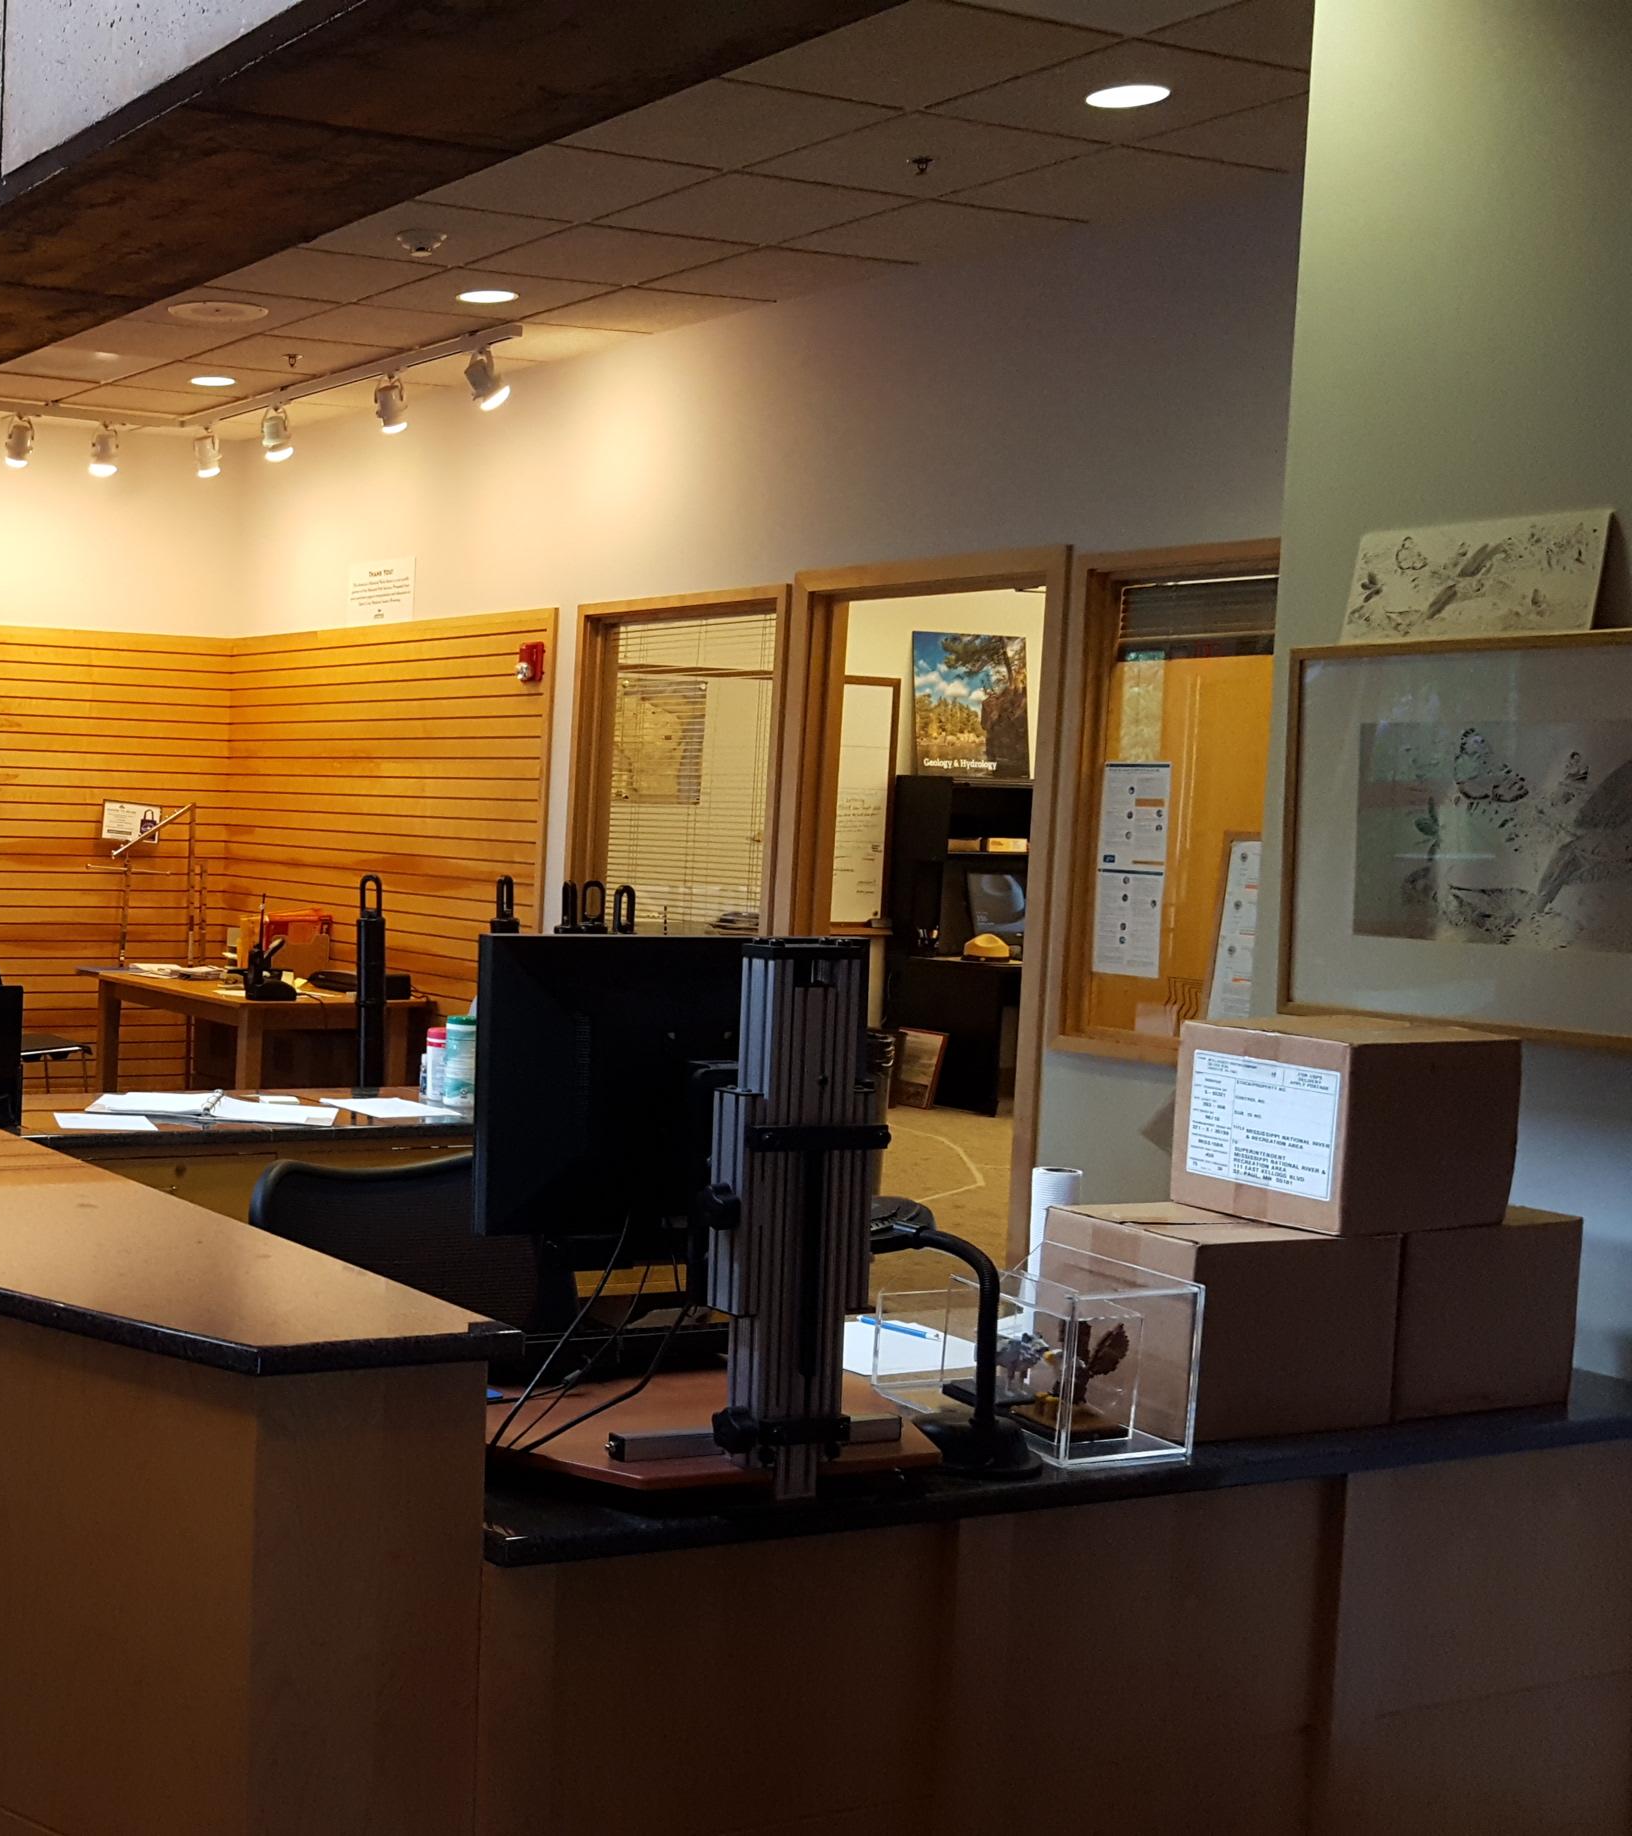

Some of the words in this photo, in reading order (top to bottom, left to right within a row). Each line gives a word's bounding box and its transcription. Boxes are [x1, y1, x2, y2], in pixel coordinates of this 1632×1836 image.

[923, 757, 953, 769] Geology
[954, 759, 959, 767] &
[960, 759, 997, 771] Hydrology
[1246, 1129, 1281, 1139] MISSISSIPPI
[1282, 1135, 1310, 1145] NATIONAL
[1251, 1136, 1286, 1146] RECREATION
[1234, 1146, 1286, 1161] SUPERINTENDENT
[1233, 1158, 1269, 1169] RECREATION
[1234, 1152, 1269, 1163] MISSISSIPPI
[1270, 1159, 1300, 1169] NATIONAL
[1301, 1165, 1320, 1173] RIVER
